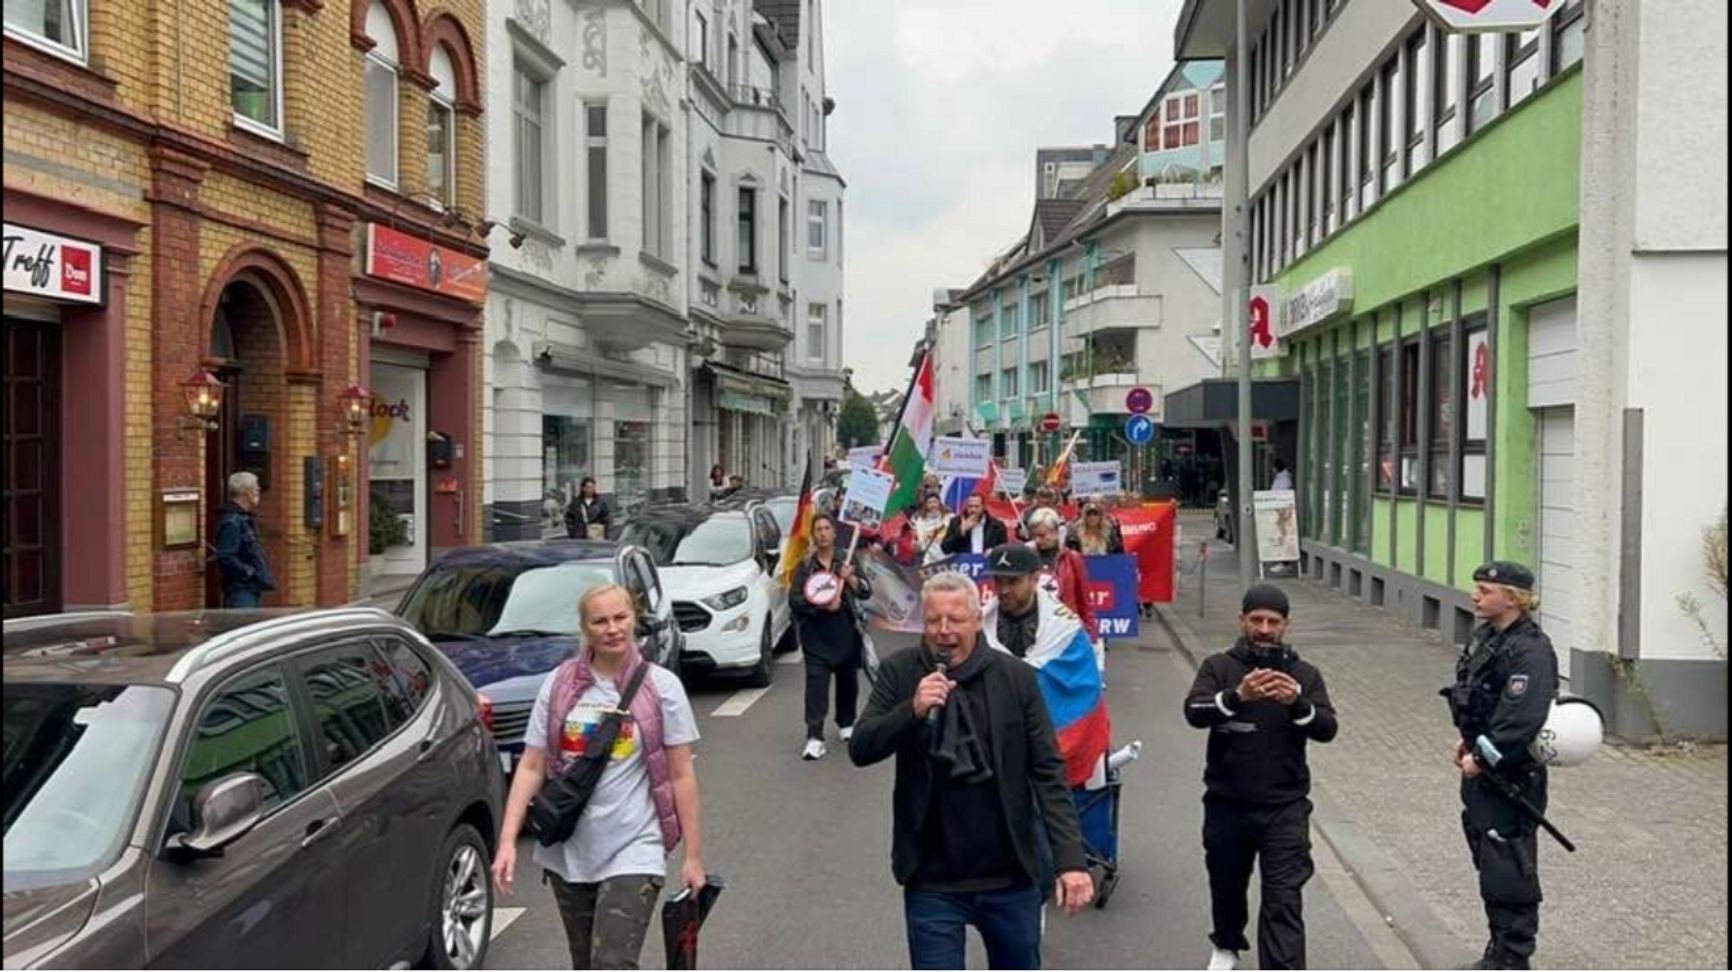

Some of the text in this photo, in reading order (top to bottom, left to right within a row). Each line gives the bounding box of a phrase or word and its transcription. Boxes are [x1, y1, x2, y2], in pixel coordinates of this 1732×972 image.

[3, 235, 56, 289] Treff
[369, 398, 411, 423] lock
[1095, 618, 1131, 634] RW
